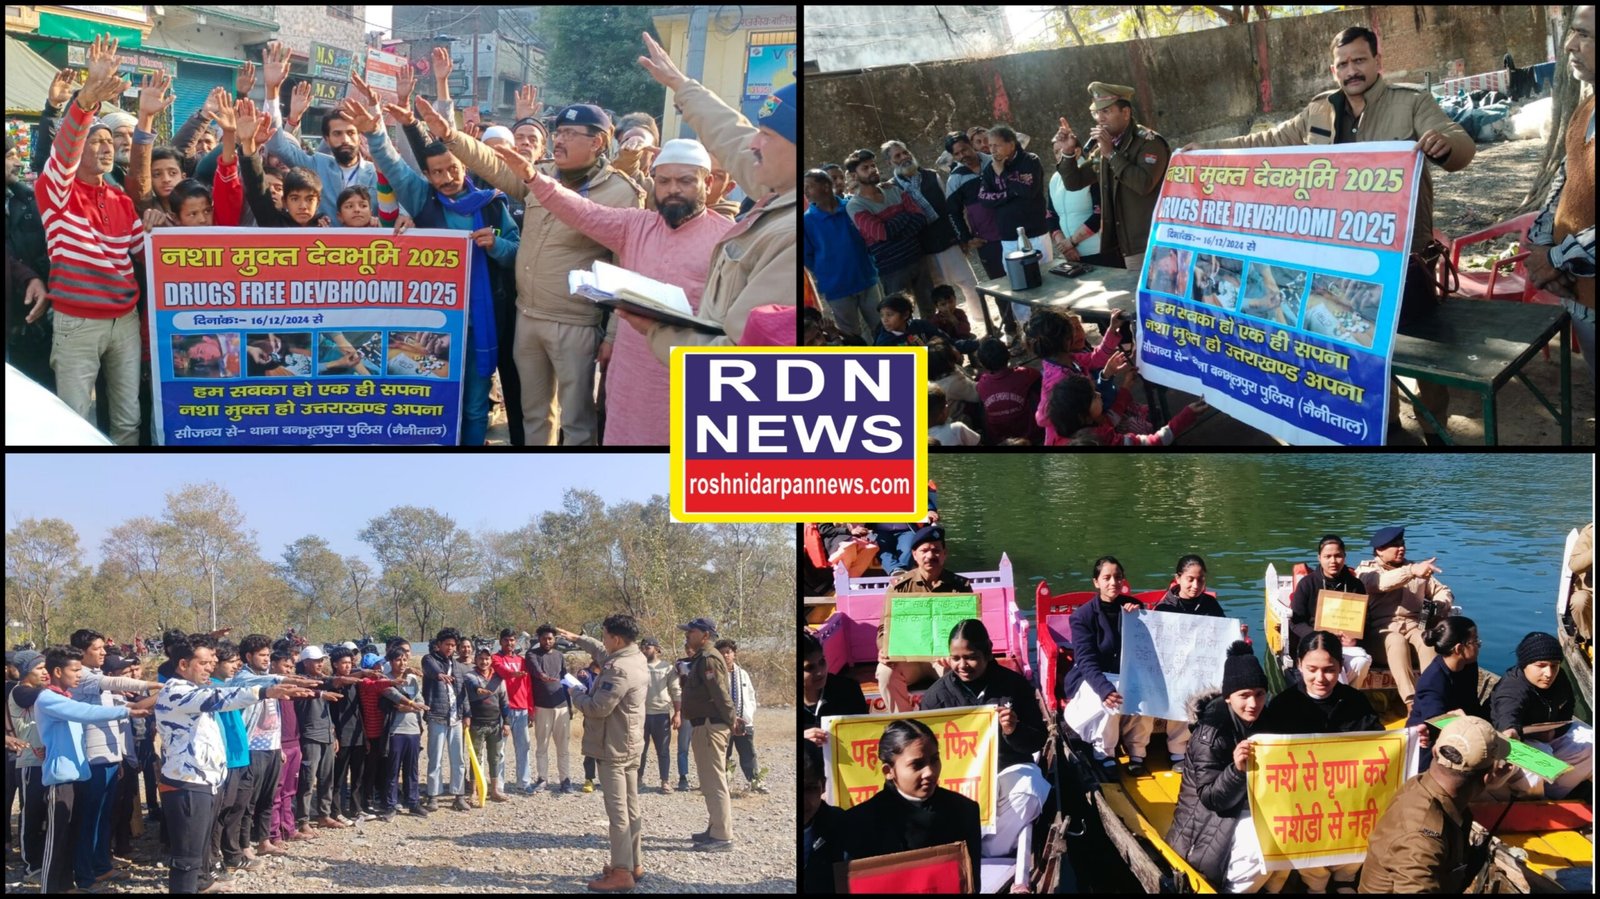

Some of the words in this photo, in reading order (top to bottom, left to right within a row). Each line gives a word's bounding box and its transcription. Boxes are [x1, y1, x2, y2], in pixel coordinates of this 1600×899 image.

[1199, 165, 1248, 195] मुक्त
[1253, 158, 1340, 201] देवभूमि
[1342, 168, 1404, 193] 2025
[1200, 199, 1231, 225] FREE
[1232, 202, 1338, 234] DEVBHOOMI
[1340, 213, 1397, 245] 2025
[1203, 234, 1245, 251] 16/12/2024
[1246, 239, 1257, 252] से
[160, 247, 224, 267] नशा
[230, 246, 300, 277] मुक्त
[306, 240, 402, 275] देवभूमि
[407, 249, 460, 269] 2025
[164, 281, 236, 306] DRUGS
[240, 281, 287, 306] FREE
[290, 280, 403, 305] DEVBHOOMI
[406, 280, 458, 306] 2025
[251, 315, 310, 326] 16/12/2024
[312, 313, 324, 325] से
[1155, 301, 1177, 320] हम
[1219, 317, 1236, 337] हो
[1238, 324, 1267, 343] एक
[1270, 328, 1291, 352] ही
[1293, 339, 1351, 370] सपना
[1145, 319, 1171, 337] नशा
[1205, 332, 1222, 353] हो
[1224, 340, 1299, 383] उत्तराखण्ड
[1302, 368, 1365, 405] अपना
[179, 404, 220, 417] नशा
[224, 403, 270, 422] मुक्त
[275, 400, 296, 417] हो
[301, 402, 386, 417] उत्तराखण्ड
[391, 404, 444, 417] अपना
[193, 386, 224, 399] हम
[229, 384, 287, 398] सबका
[293, 381, 313, 397] हो
[317, 384, 351, 396] एक
[355, 380, 375, 397] ही
[379, 385, 432, 398] सपना
[1143, 340, 1172, 359] सौजन्य
[1260, 382, 1295, 408] पुलिस
[1297, 396, 1369, 442] (नैनीताल)
[174, 426, 222, 440] सौजन्य
[249, 425, 280, 437] थाना
[282, 424, 344, 440] बनभूलपुरा
[347, 422, 383, 439] पुलिस
[387, 422, 448, 438] (नैनीताल)
[851, 738, 880, 771] पह
[943, 720, 979, 760] फिर
[1266, 751, 1299, 793] नशे
[1302, 750, 1319, 792] से
[1323, 760, 1360, 799] घृणा
[1363, 746, 1390, 788] करे
[1273, 803, 1324, 844] नशेडी
[1328, 801, 1344, 840] से
